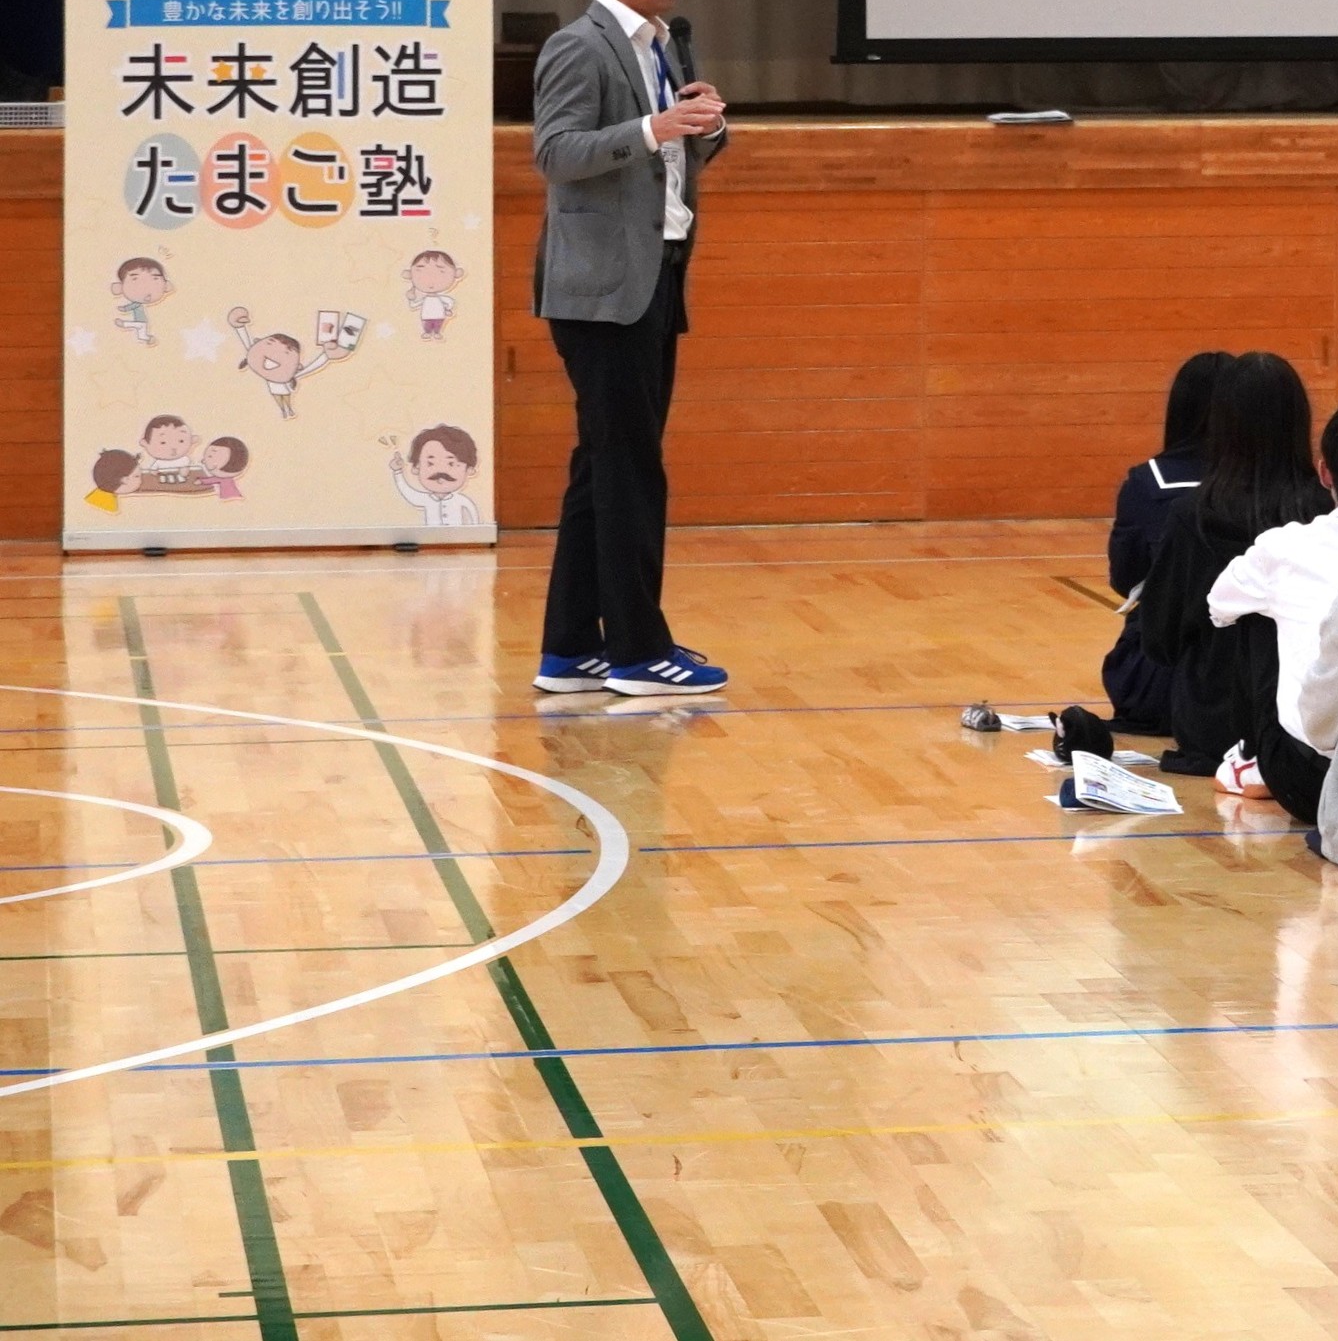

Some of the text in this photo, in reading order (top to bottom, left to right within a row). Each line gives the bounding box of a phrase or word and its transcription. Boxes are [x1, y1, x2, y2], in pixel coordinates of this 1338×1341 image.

[121, 40, 446, 120] 未来創造
[135, 143, 433, 218] たまご塾
